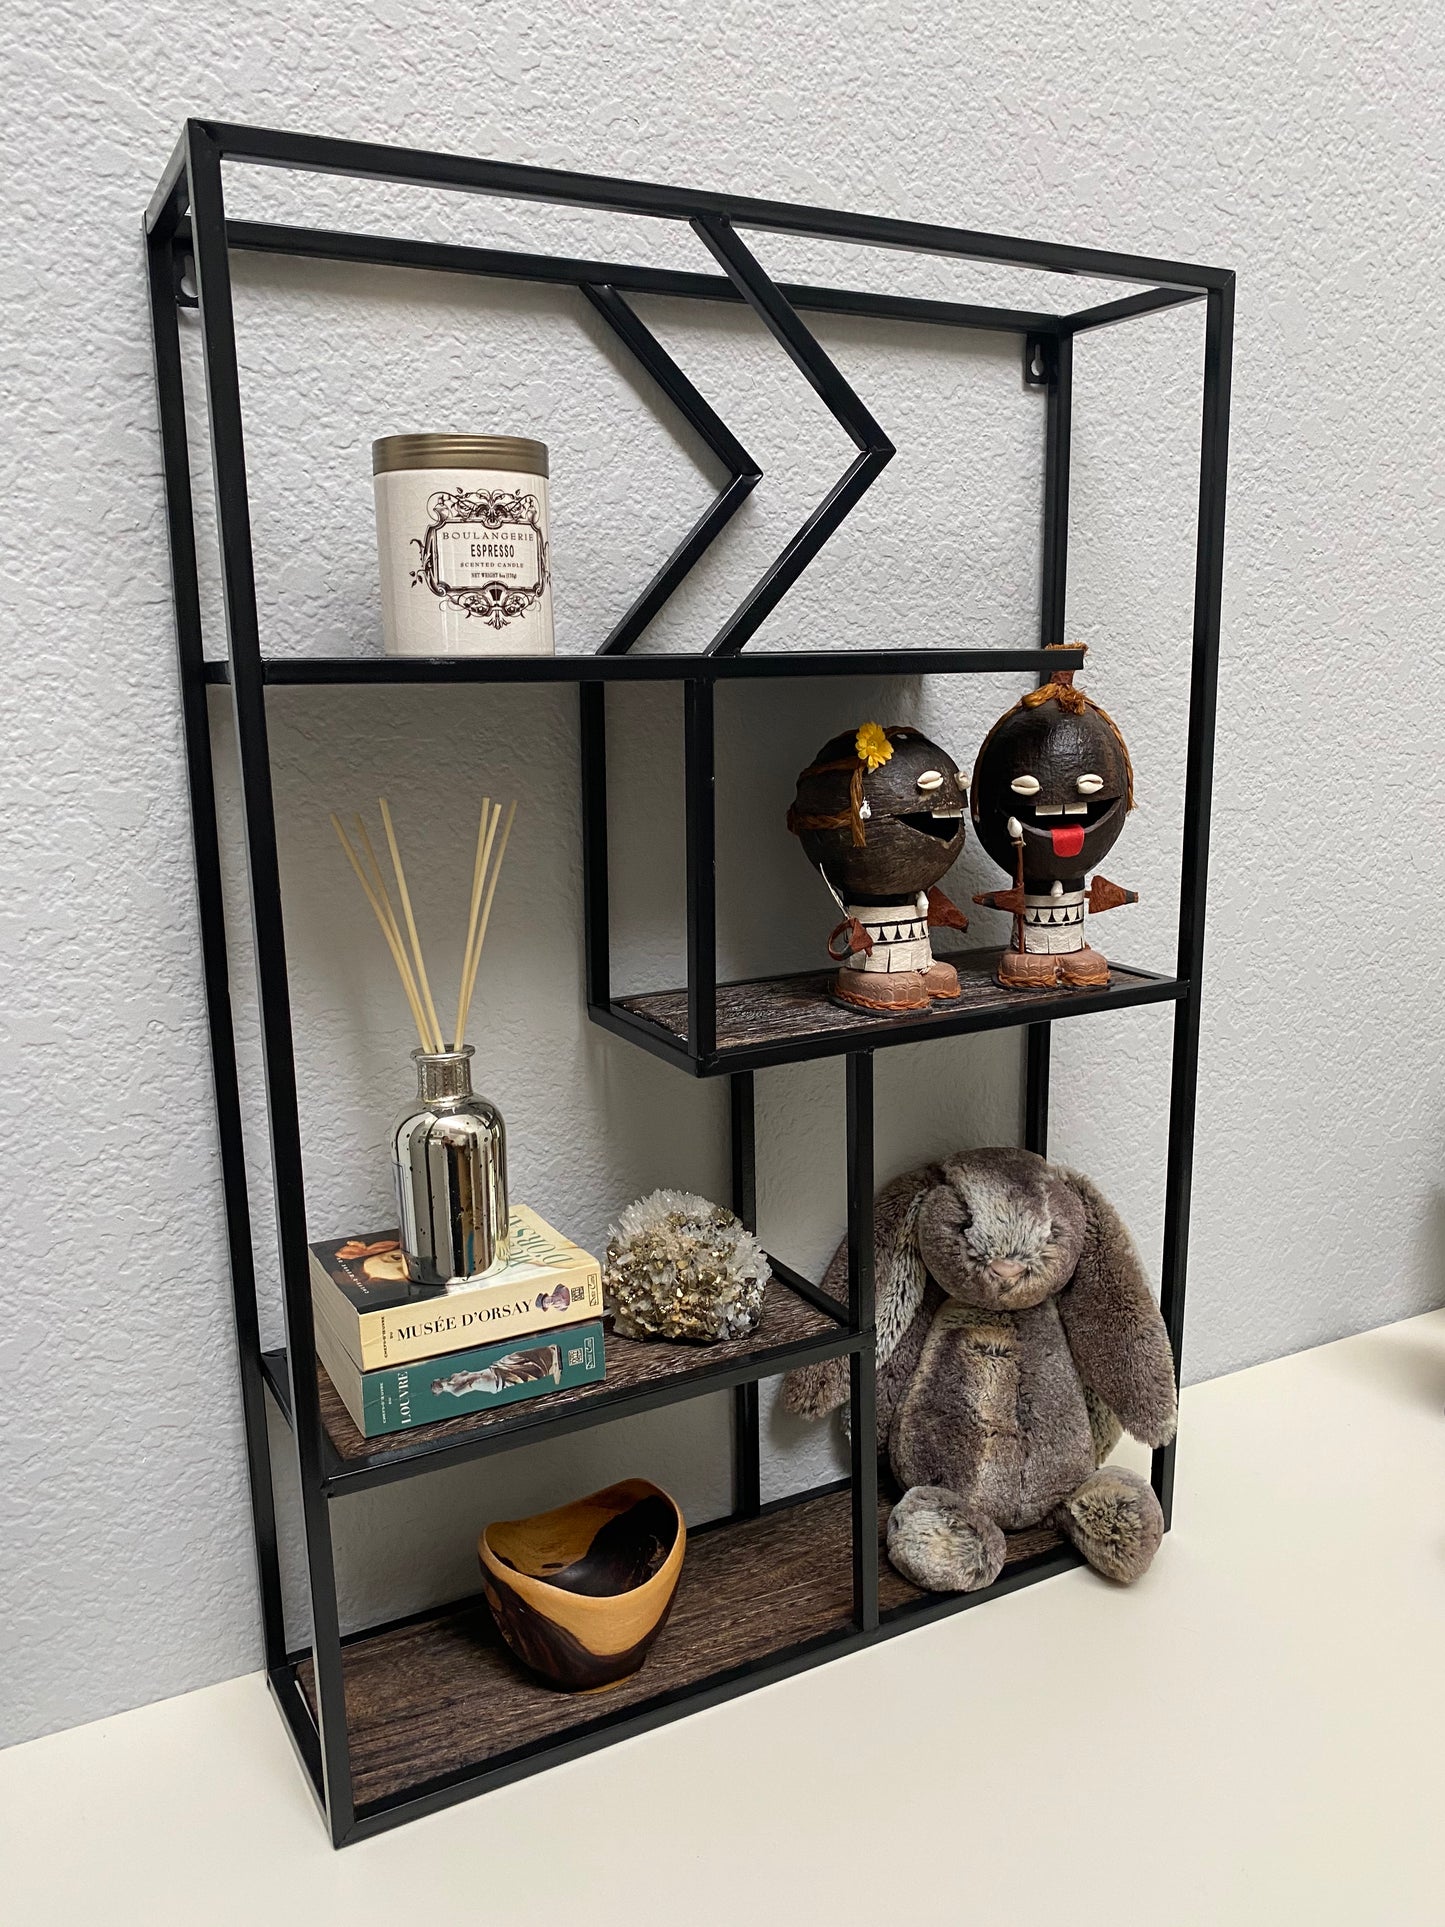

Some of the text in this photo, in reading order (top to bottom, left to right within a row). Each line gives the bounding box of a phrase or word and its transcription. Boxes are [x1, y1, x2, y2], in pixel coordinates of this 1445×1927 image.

[442, 531, 534, 541] BOULANGERIE
[470, 544, 515, 558] ESPRESSO
[397, 1299, 532, 1341] MUSÉE D'ORSAY
[398, 1370, 412, 1425] LOUVRE
